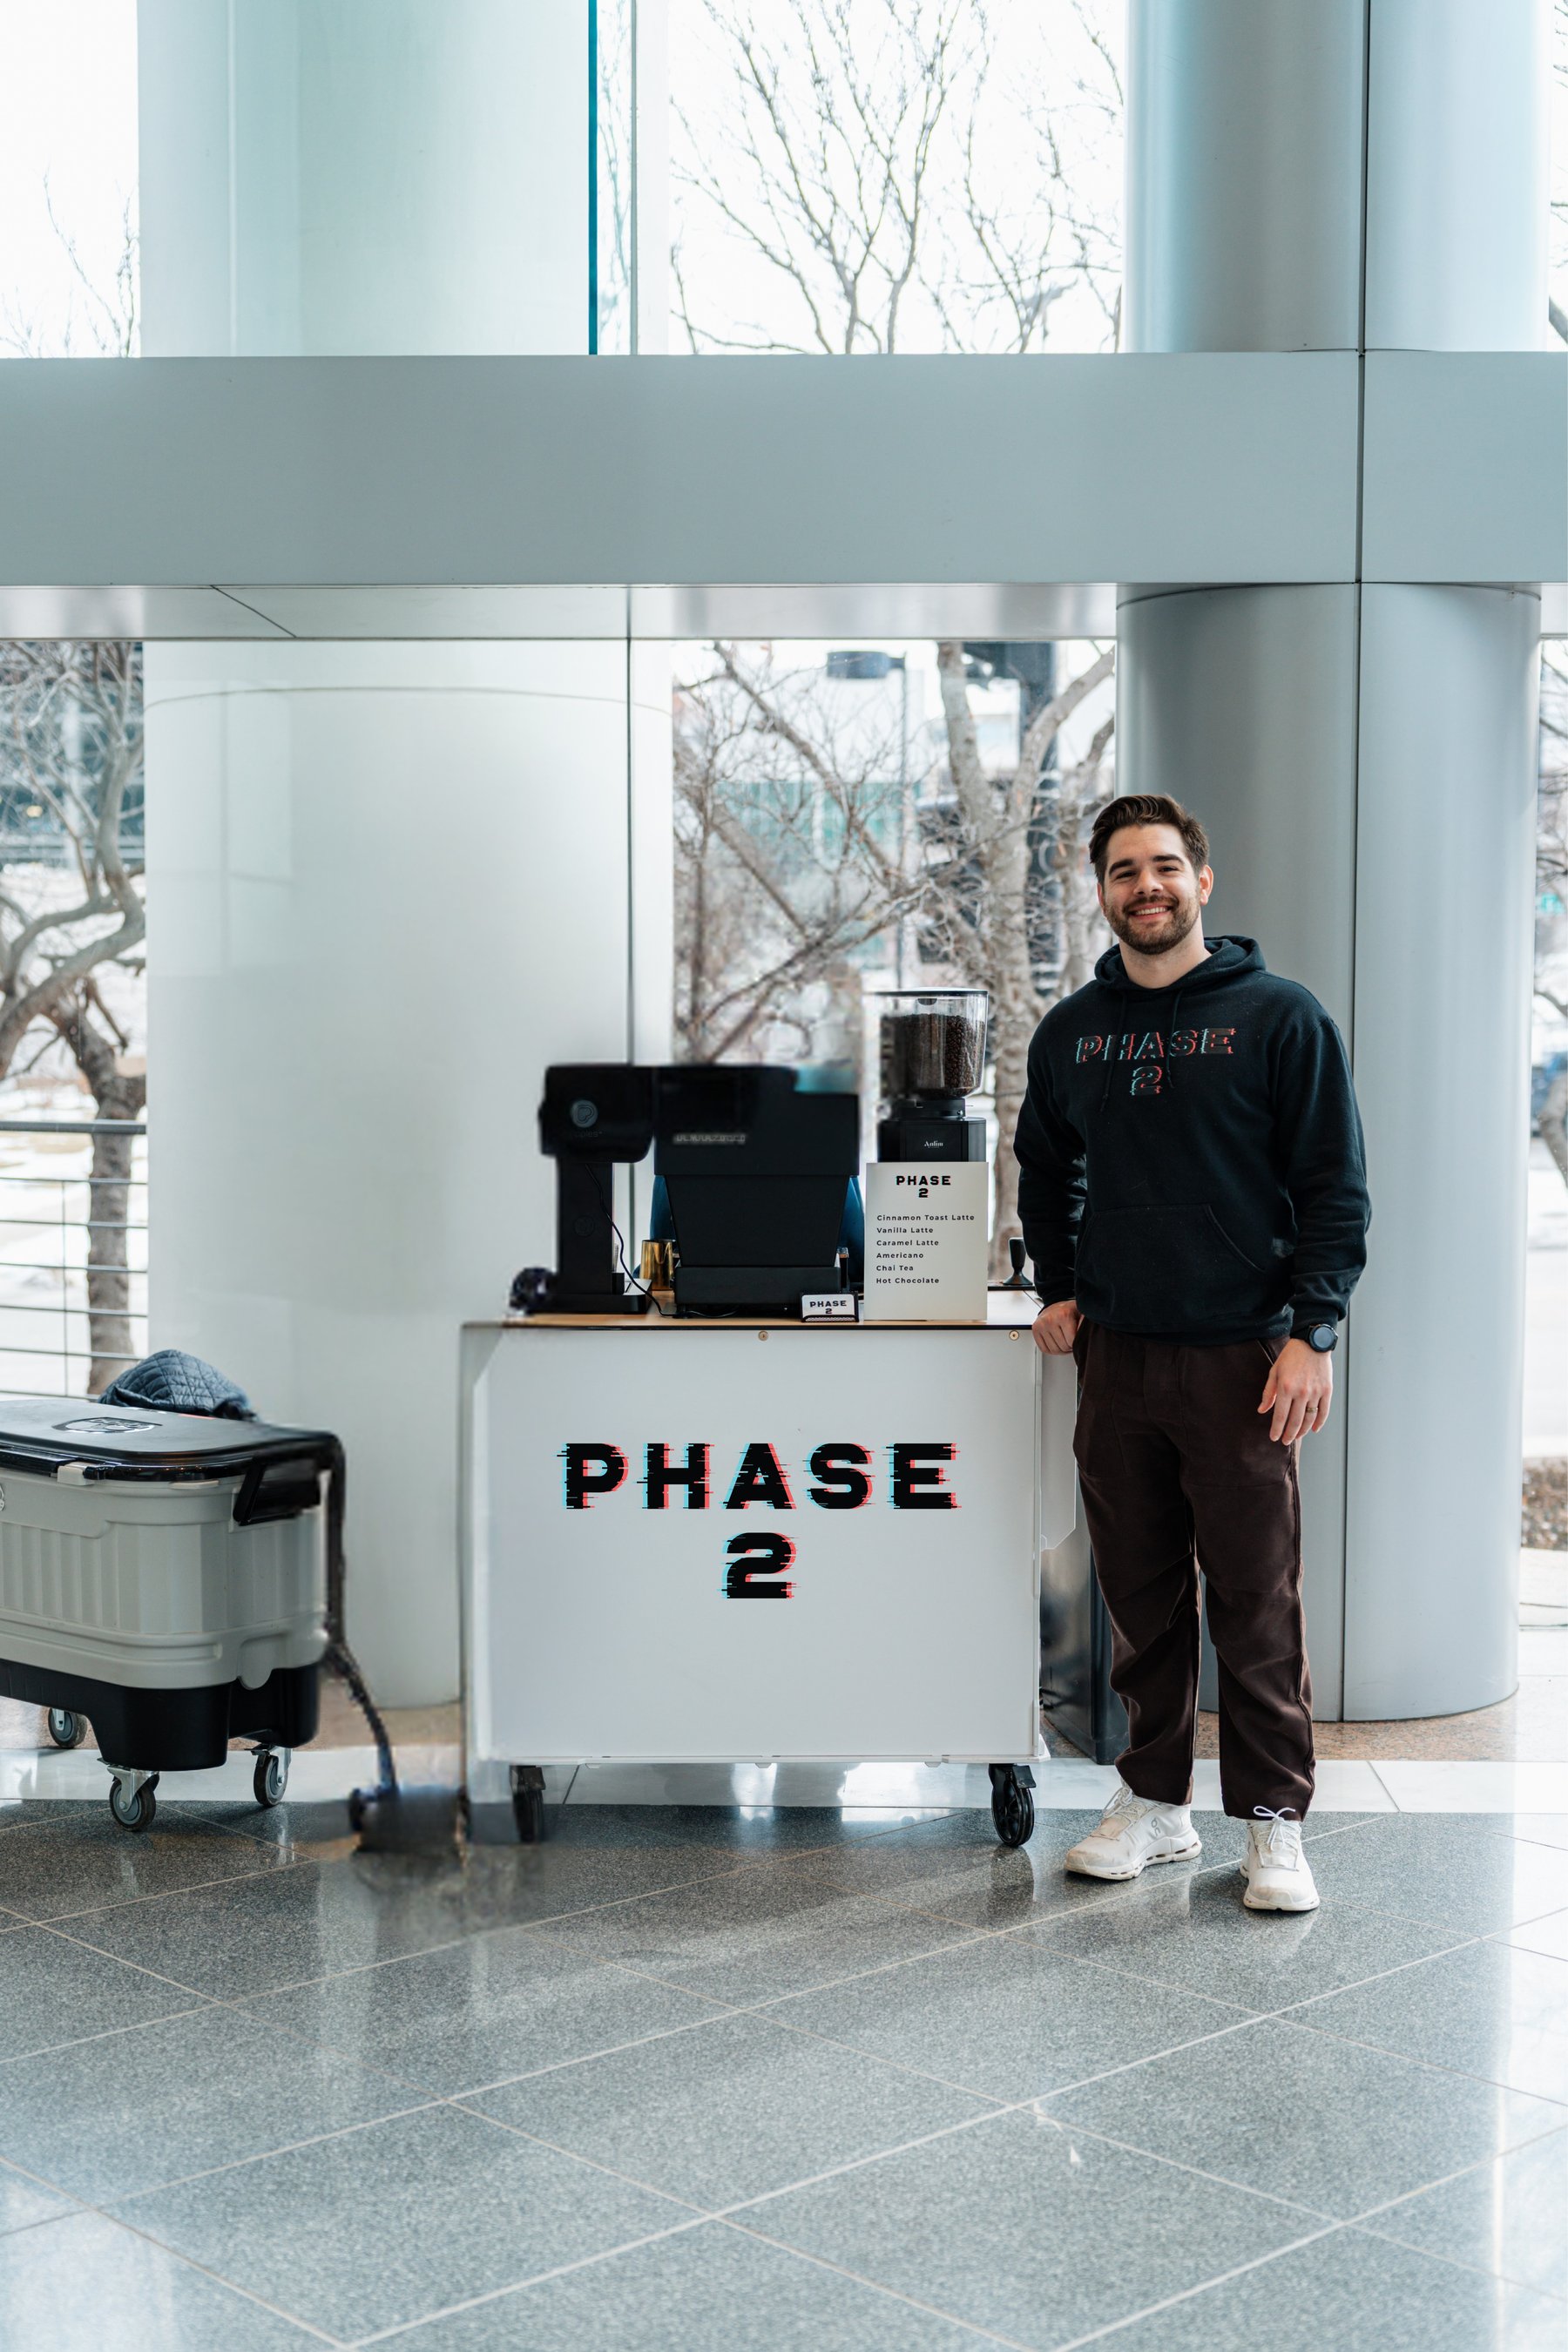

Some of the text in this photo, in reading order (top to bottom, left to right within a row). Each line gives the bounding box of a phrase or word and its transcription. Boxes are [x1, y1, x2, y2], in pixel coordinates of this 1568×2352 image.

[1076, 1028, 1237, 1064] PHASE
[1130, 1065, 1165, 1096] 2
[896, 1175, 951, 1186] PHASE
[918, 1187, 929, 1198] 2
[558, 1443, 961, 1510] PHASE
[720, 1532, 799, 1599] 2
